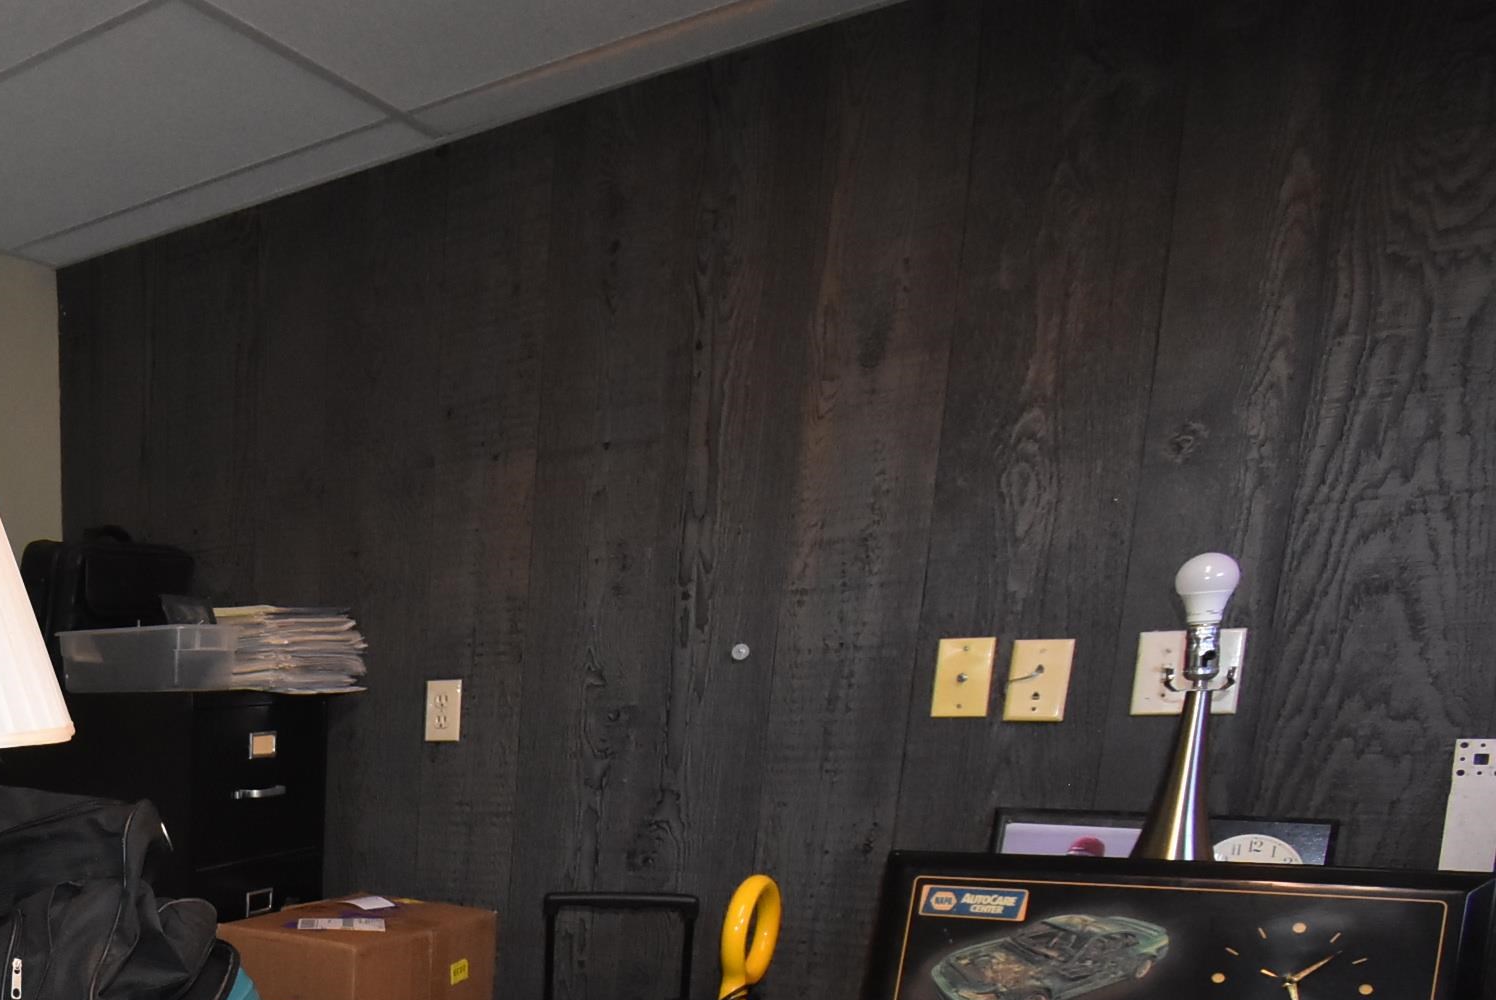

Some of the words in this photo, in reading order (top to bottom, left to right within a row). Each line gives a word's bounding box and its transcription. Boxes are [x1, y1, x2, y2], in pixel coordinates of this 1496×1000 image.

[1231, 843, 1242, 856] 11
[1248, 839, 1264, 853] 12
[969, 905, 1004, 914] CENTER
